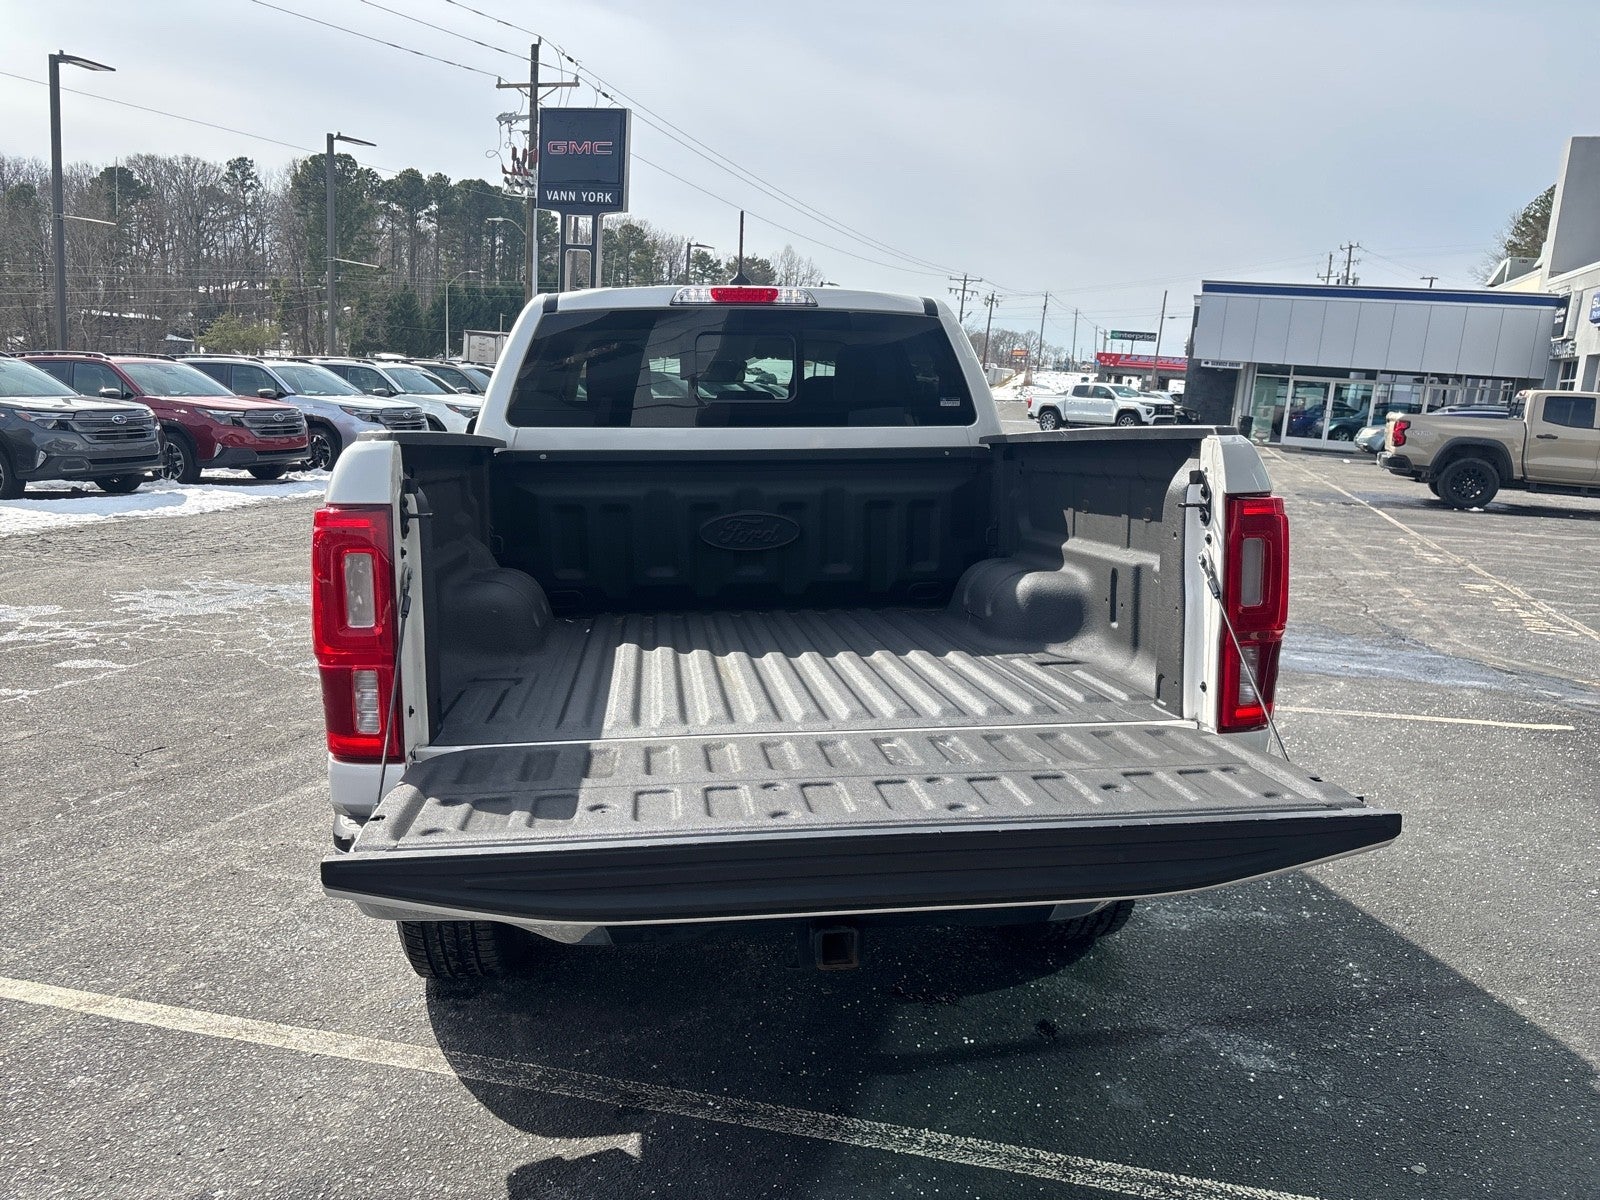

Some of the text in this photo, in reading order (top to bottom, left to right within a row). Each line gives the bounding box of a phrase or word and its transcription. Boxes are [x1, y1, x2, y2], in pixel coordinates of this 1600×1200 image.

[548, 141, 613, 155] GMC
[546, 190, 613, 203] VANN YORK
[1112, 332, 1156, 341] enterprise
[719, 518, 780, 543] Ford
